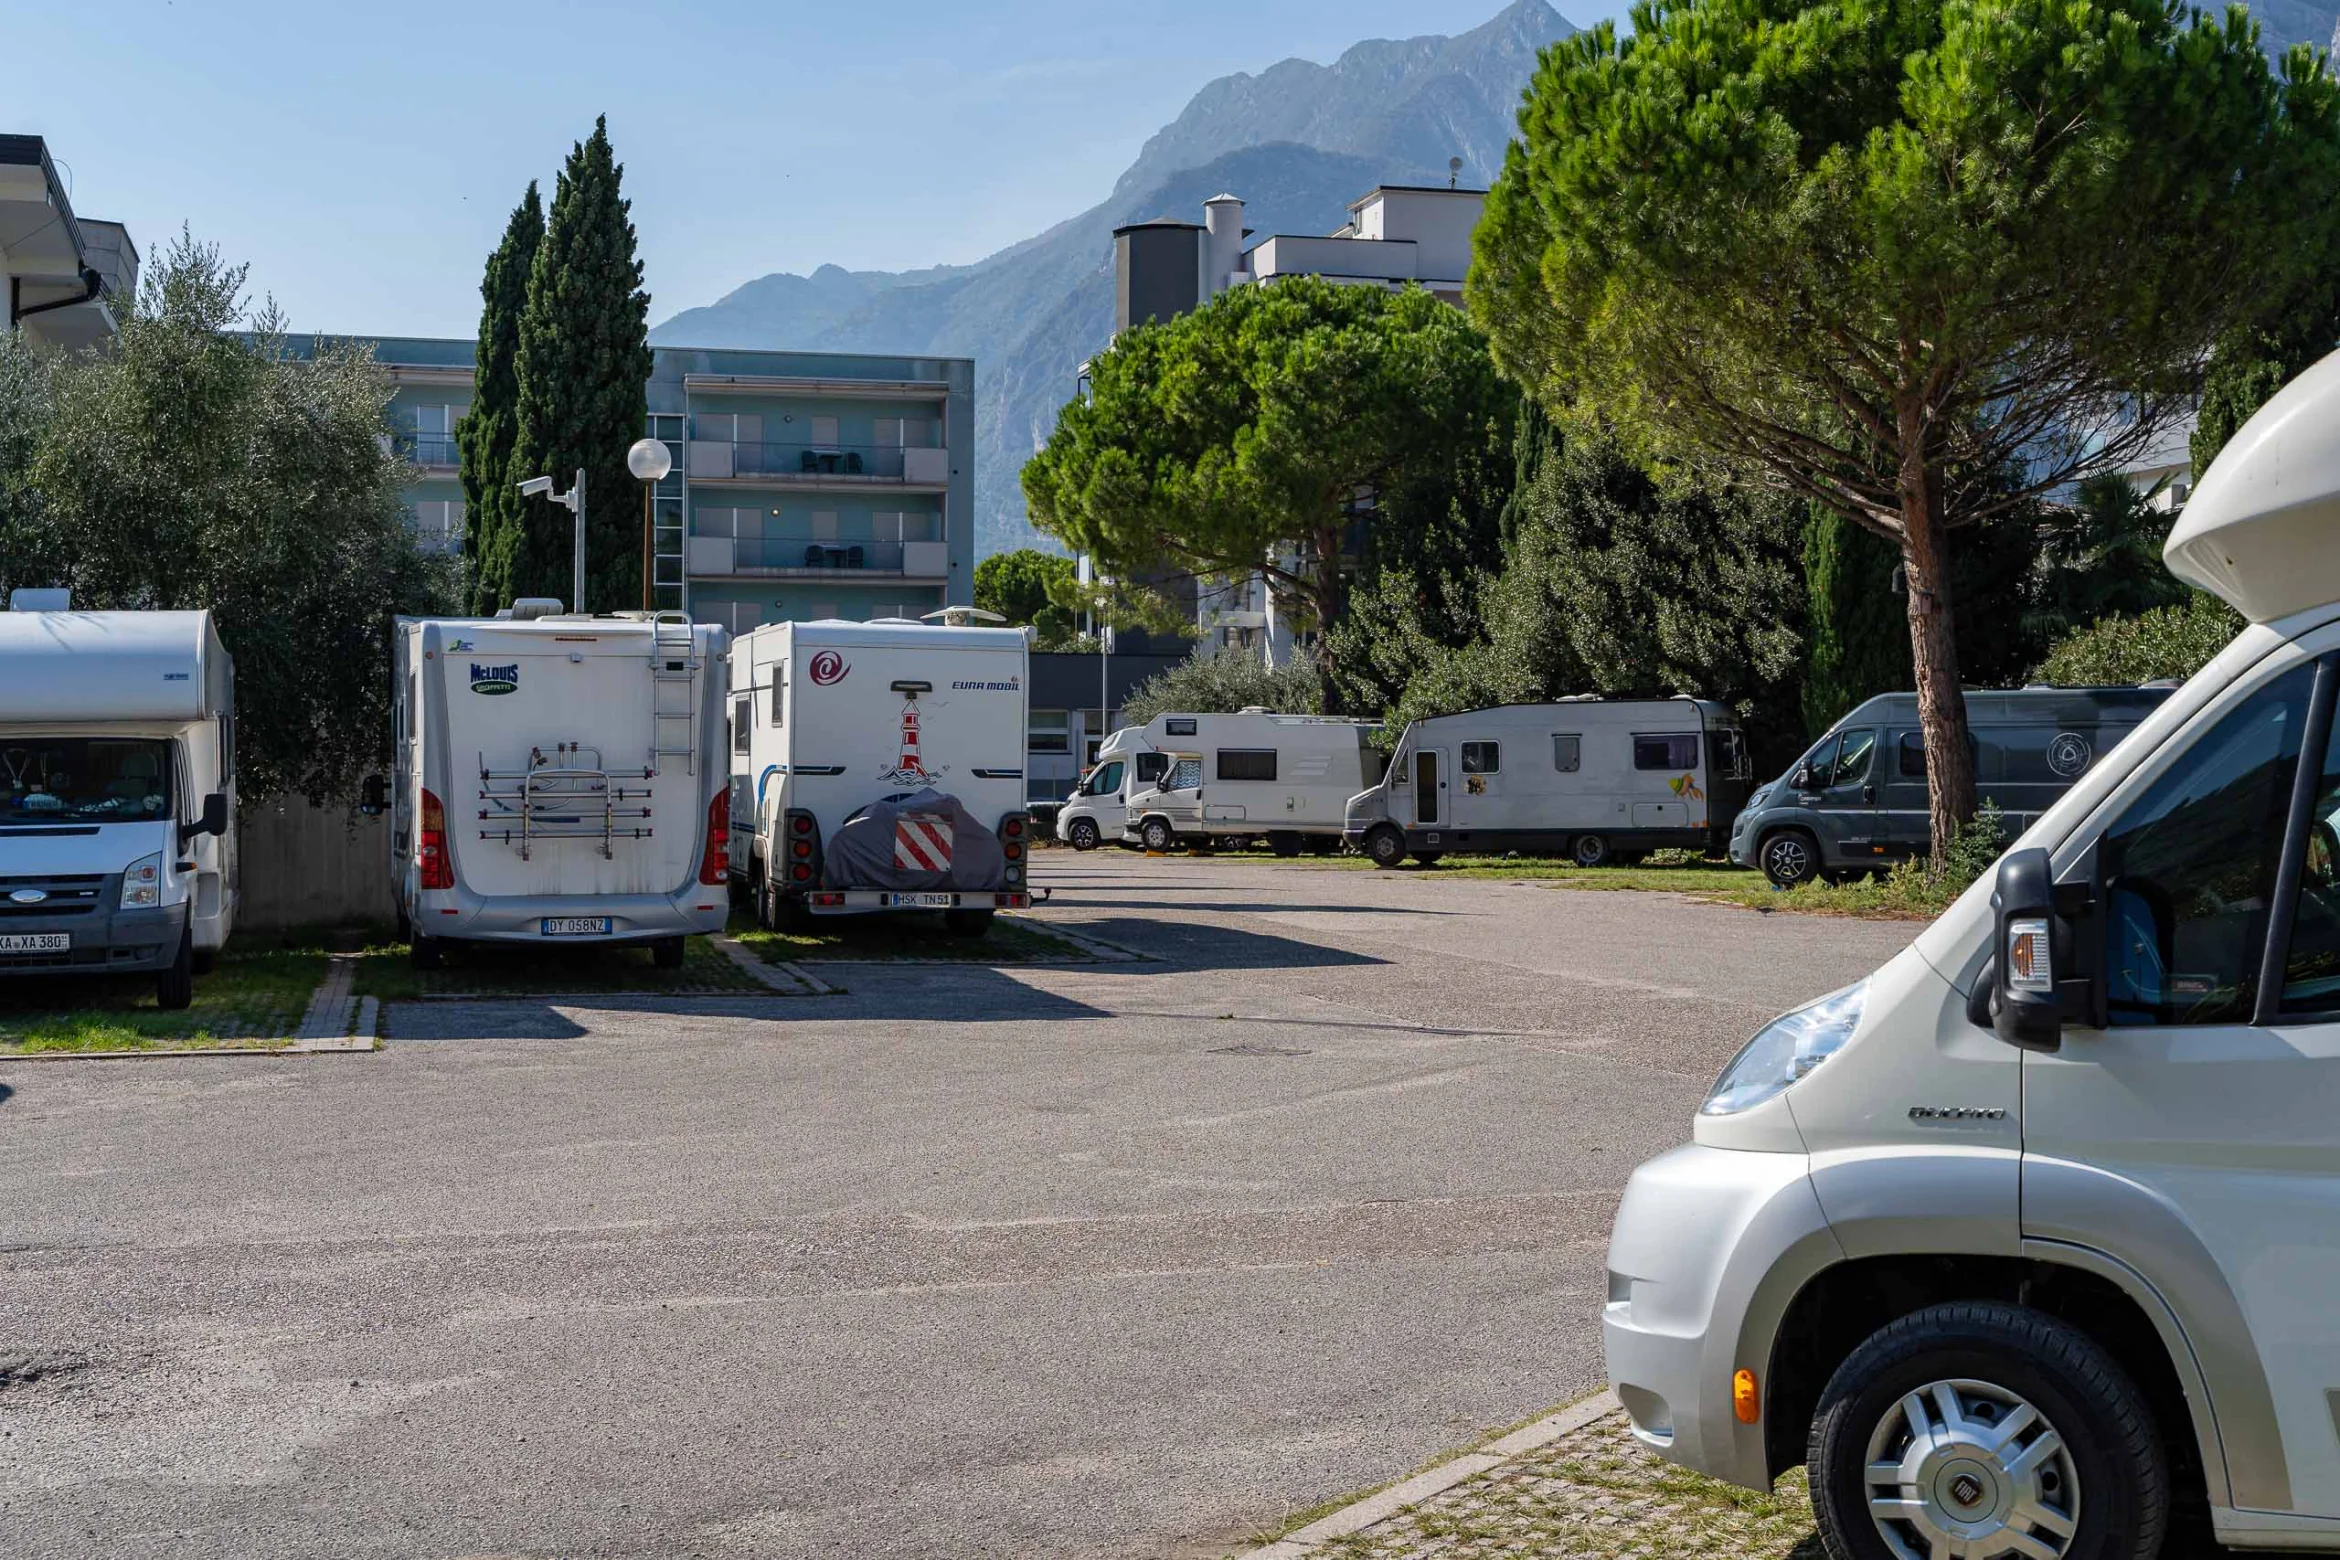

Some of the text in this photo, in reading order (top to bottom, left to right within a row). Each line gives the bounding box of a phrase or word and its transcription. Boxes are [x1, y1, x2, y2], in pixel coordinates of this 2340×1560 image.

[471, 663, 518, 683] McLOUIS
[951, 681, 1020, 691] EURA MOBIL
[899, 894, 916, 904] HSK
[924, 894, 936, 904] TN
[550, 920, 564, 932] DY
[21, 936, 37, 949] XA
[39, 935, 61, 948] 380
[1954, 1480, 1978, 1502] FIAT
